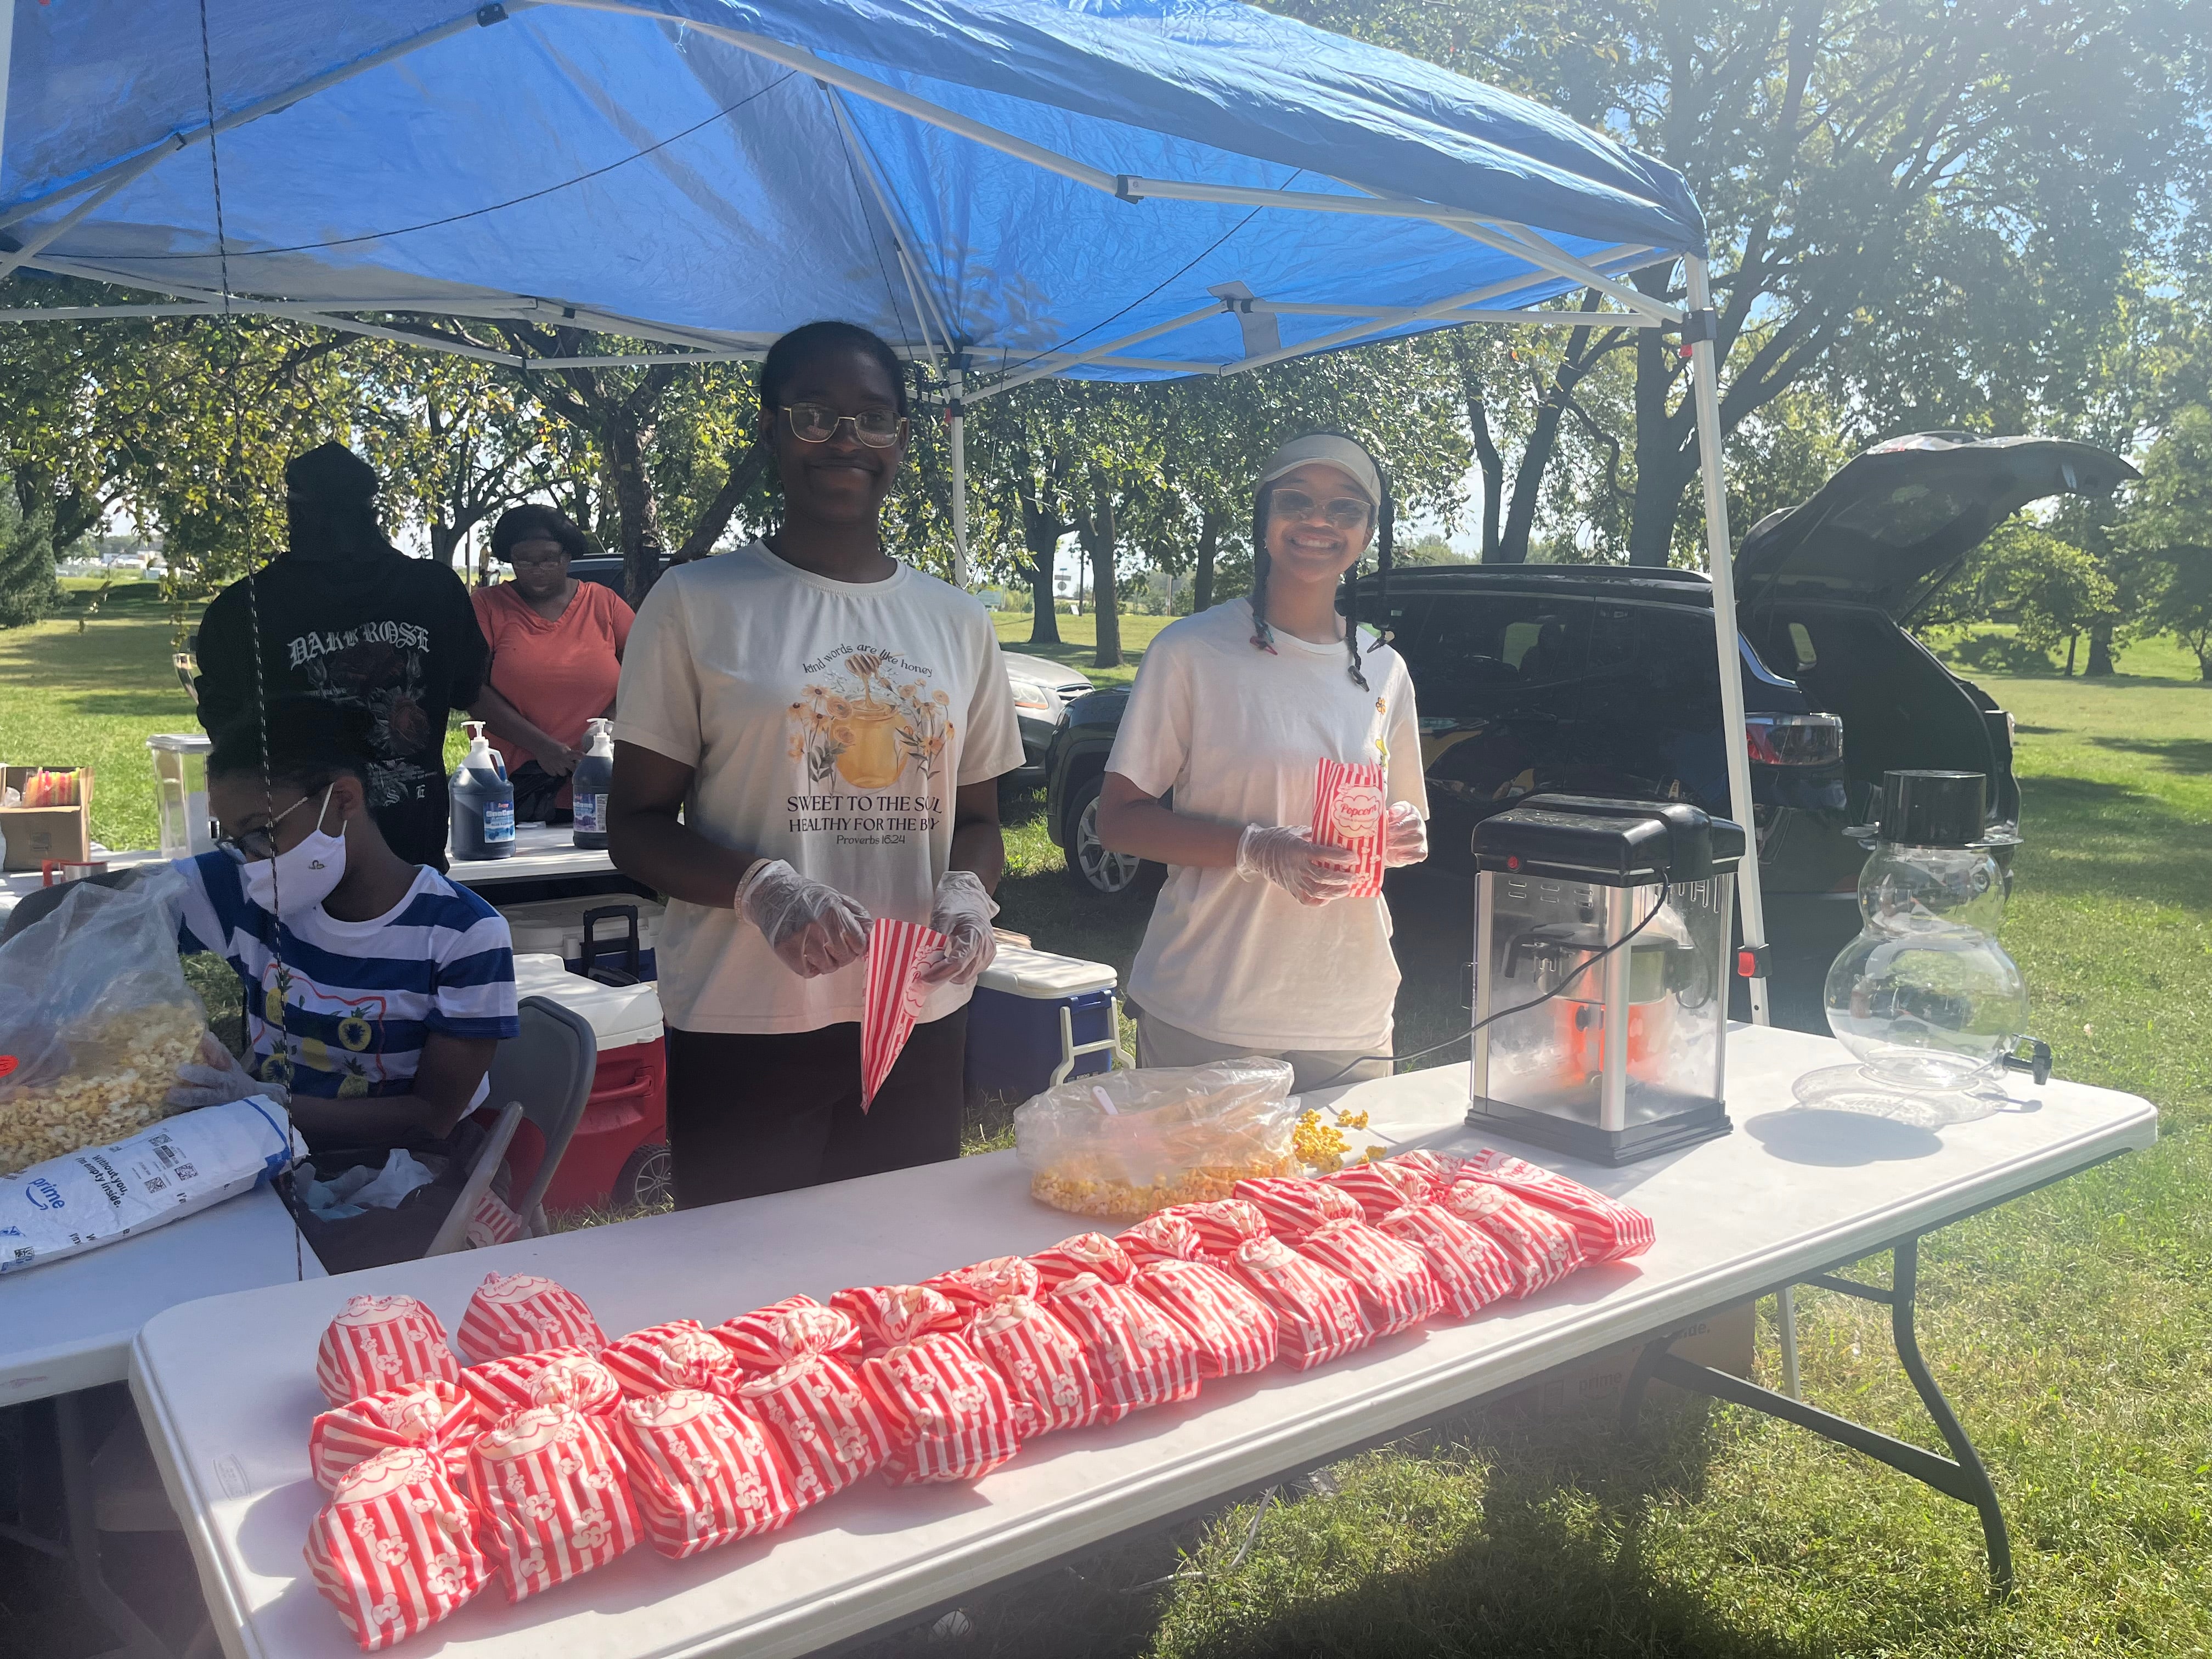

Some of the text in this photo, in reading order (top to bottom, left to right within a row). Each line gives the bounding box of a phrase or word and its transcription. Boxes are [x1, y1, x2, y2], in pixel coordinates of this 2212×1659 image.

[359, 620, 430, 653] ROSE
[803, 644, 933, 678] kind words are like honey
[787, 795, 842, 812] SWEET
[847, 795, 873, 811] TO
[877, 796, 911, 811] THE
[1340, 803, 1378, 818] Popcorn
[789, 817, 851, 832] HEALTHY
[854, 817, 884, 831] FOR
[887, 817, 917, 831] THE
[837, 834, 879, 844] Proverbs
[83, 1163, 106, 1183] empty
[101, 1181, 122, 1208] inside.
[92, 1154, 128, 1196] Without you,
[28, 1178, 65, 1209] prime
